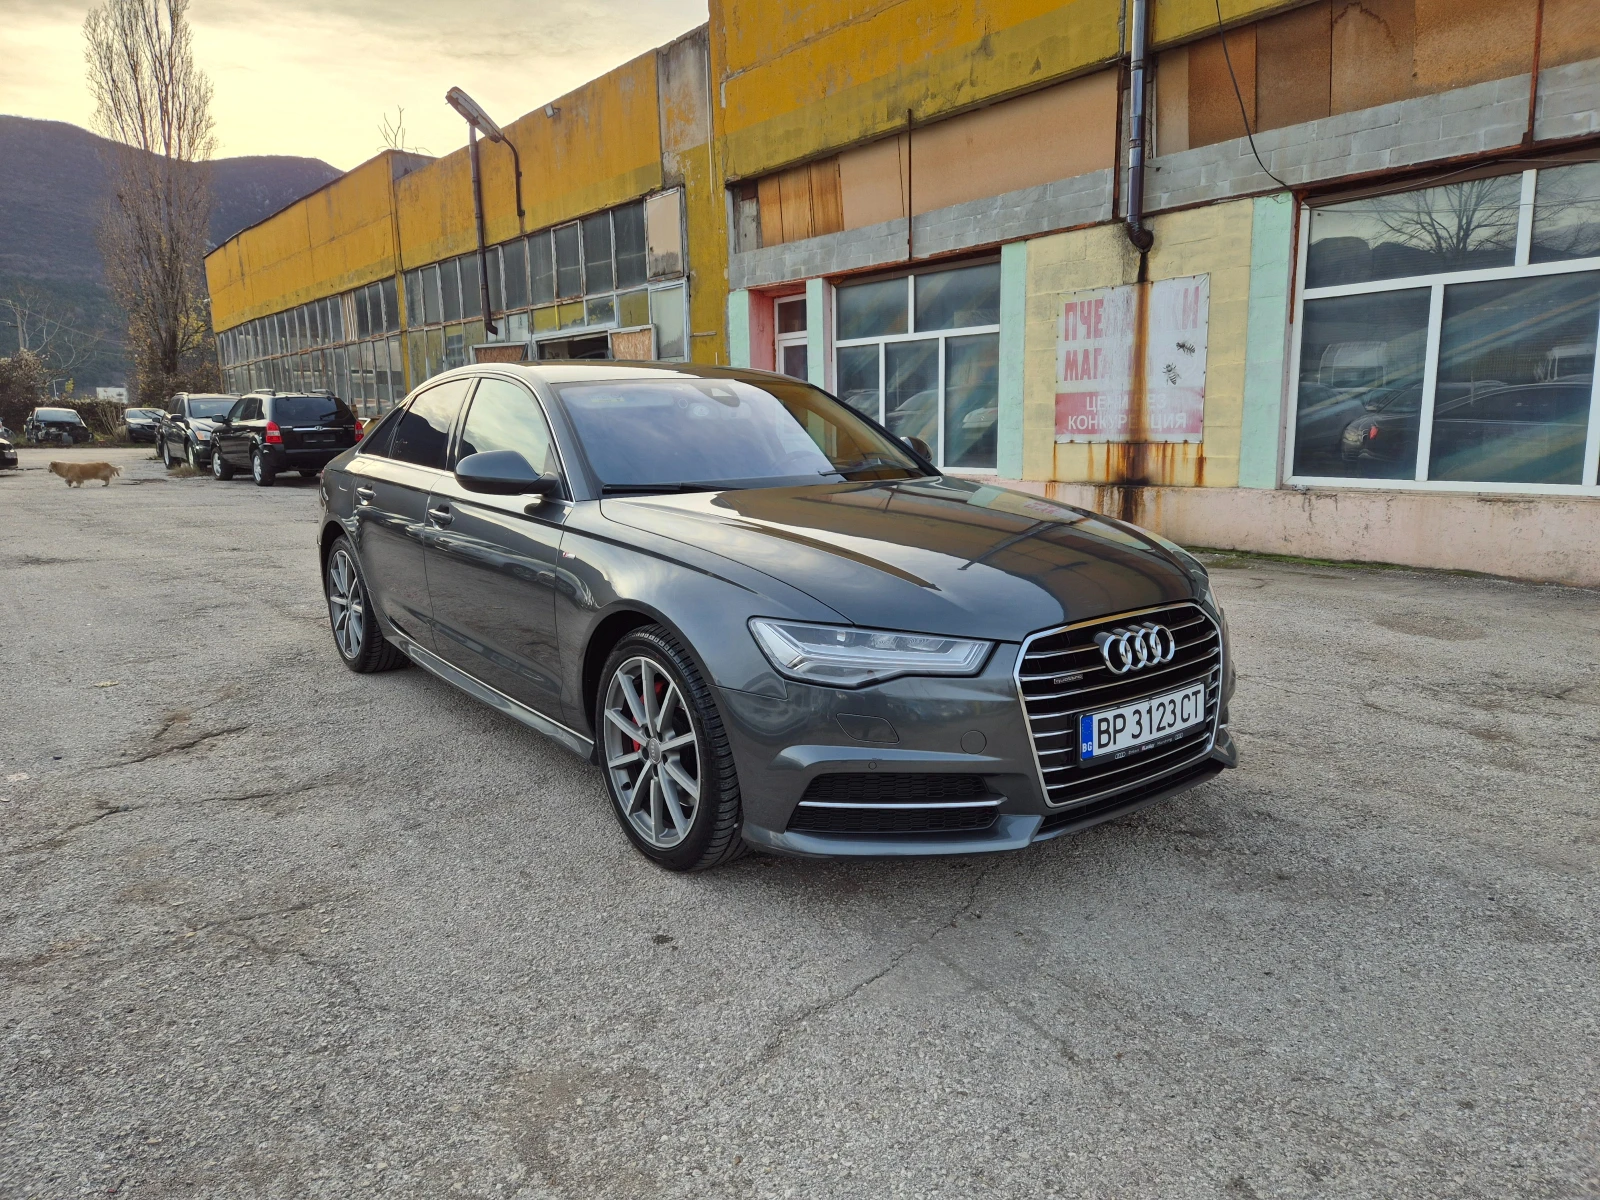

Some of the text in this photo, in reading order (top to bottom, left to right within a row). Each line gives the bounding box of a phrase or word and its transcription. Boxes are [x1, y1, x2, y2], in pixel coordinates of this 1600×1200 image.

[1068, 412, 1187, 431] КОНКУРЕЦИЯ
[1097, 713, 1127, 750] BP
[1131, 698, 1177, 740] 3123
[1180, 689, 1201, 723] CT
[1081, 741, 1093, 753] BG
